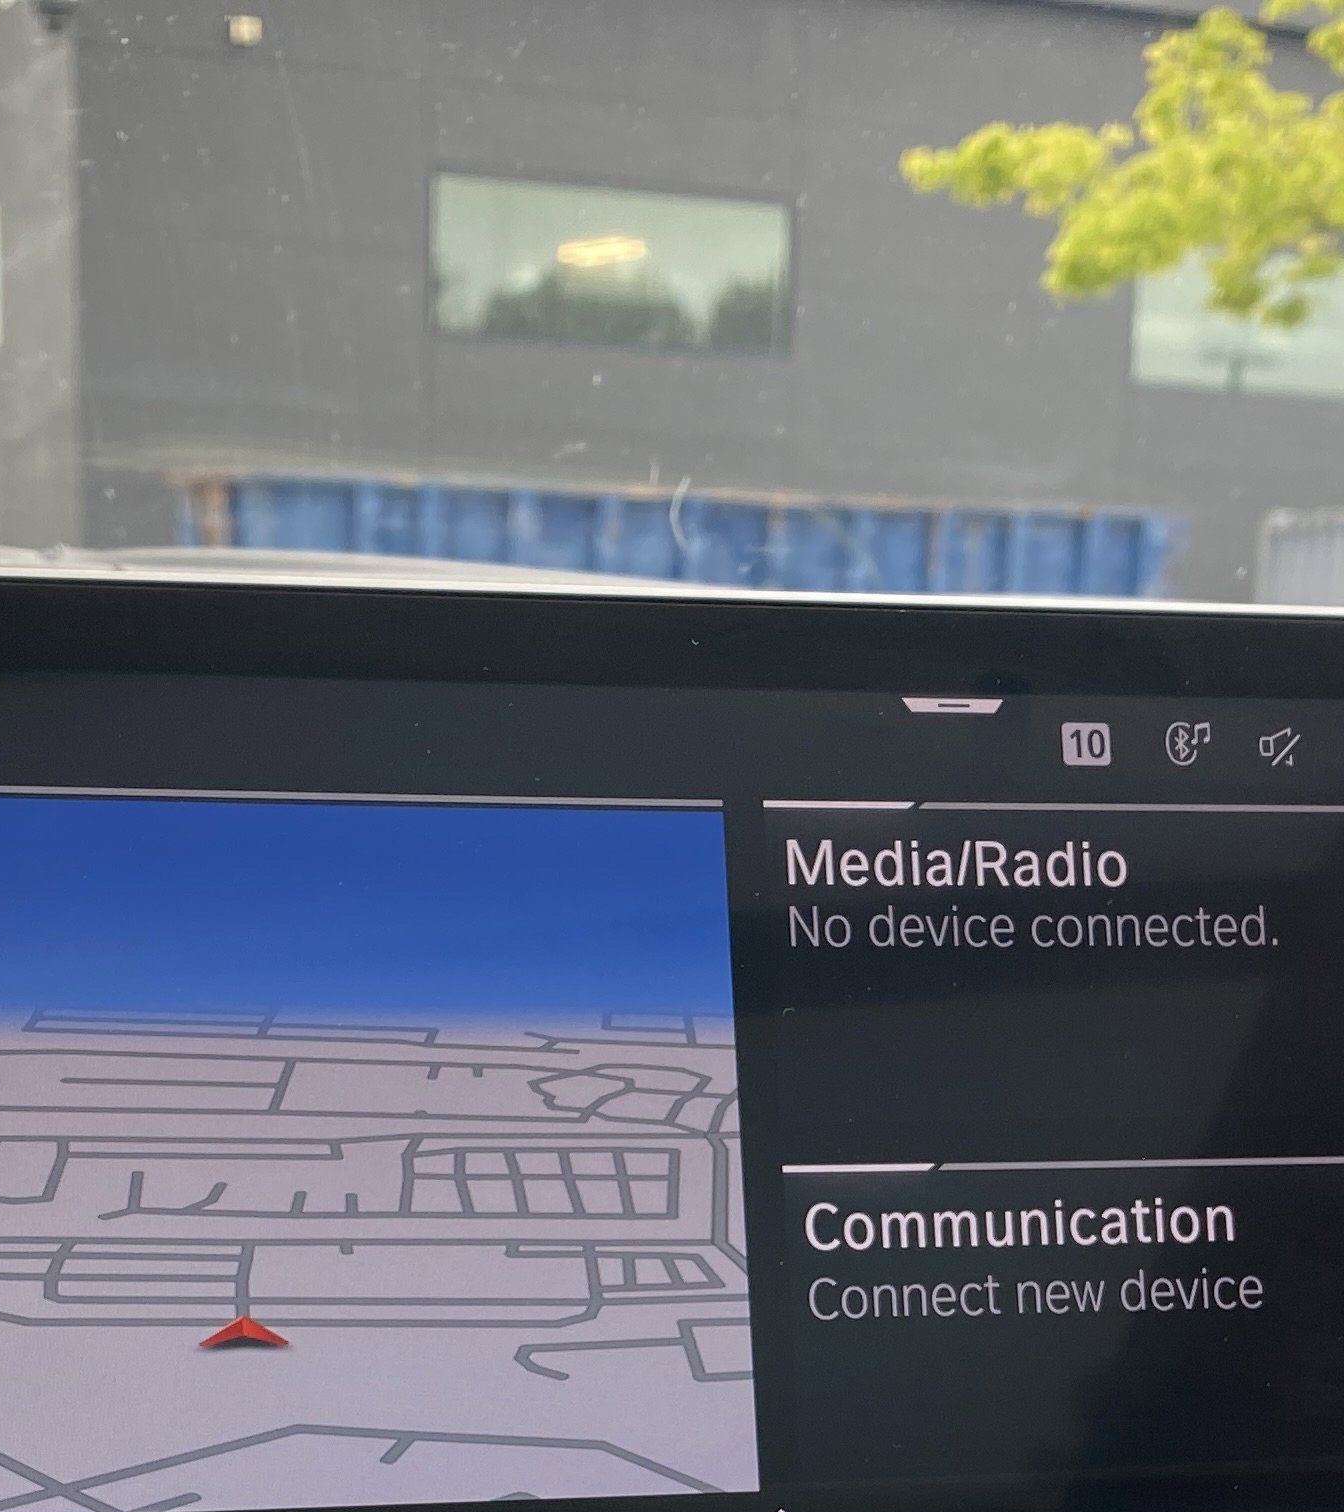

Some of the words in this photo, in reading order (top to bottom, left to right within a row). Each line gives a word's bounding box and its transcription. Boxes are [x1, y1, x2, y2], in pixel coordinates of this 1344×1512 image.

[1069, 729, 1106, 759] 10
[786, 839, 1127, 888] Media/Radio
[789, 905, 851, 948] No
[868, 904, 1015, 948] device
[1031, 904, 1279, 948] connected.
[805, 1197, 1234, 1251] Communication
[808, 1274, 1001, 1321] Connect
[1016, 1280, 1105, 1315] new
[1120, 1267, 1263, 1312] device
